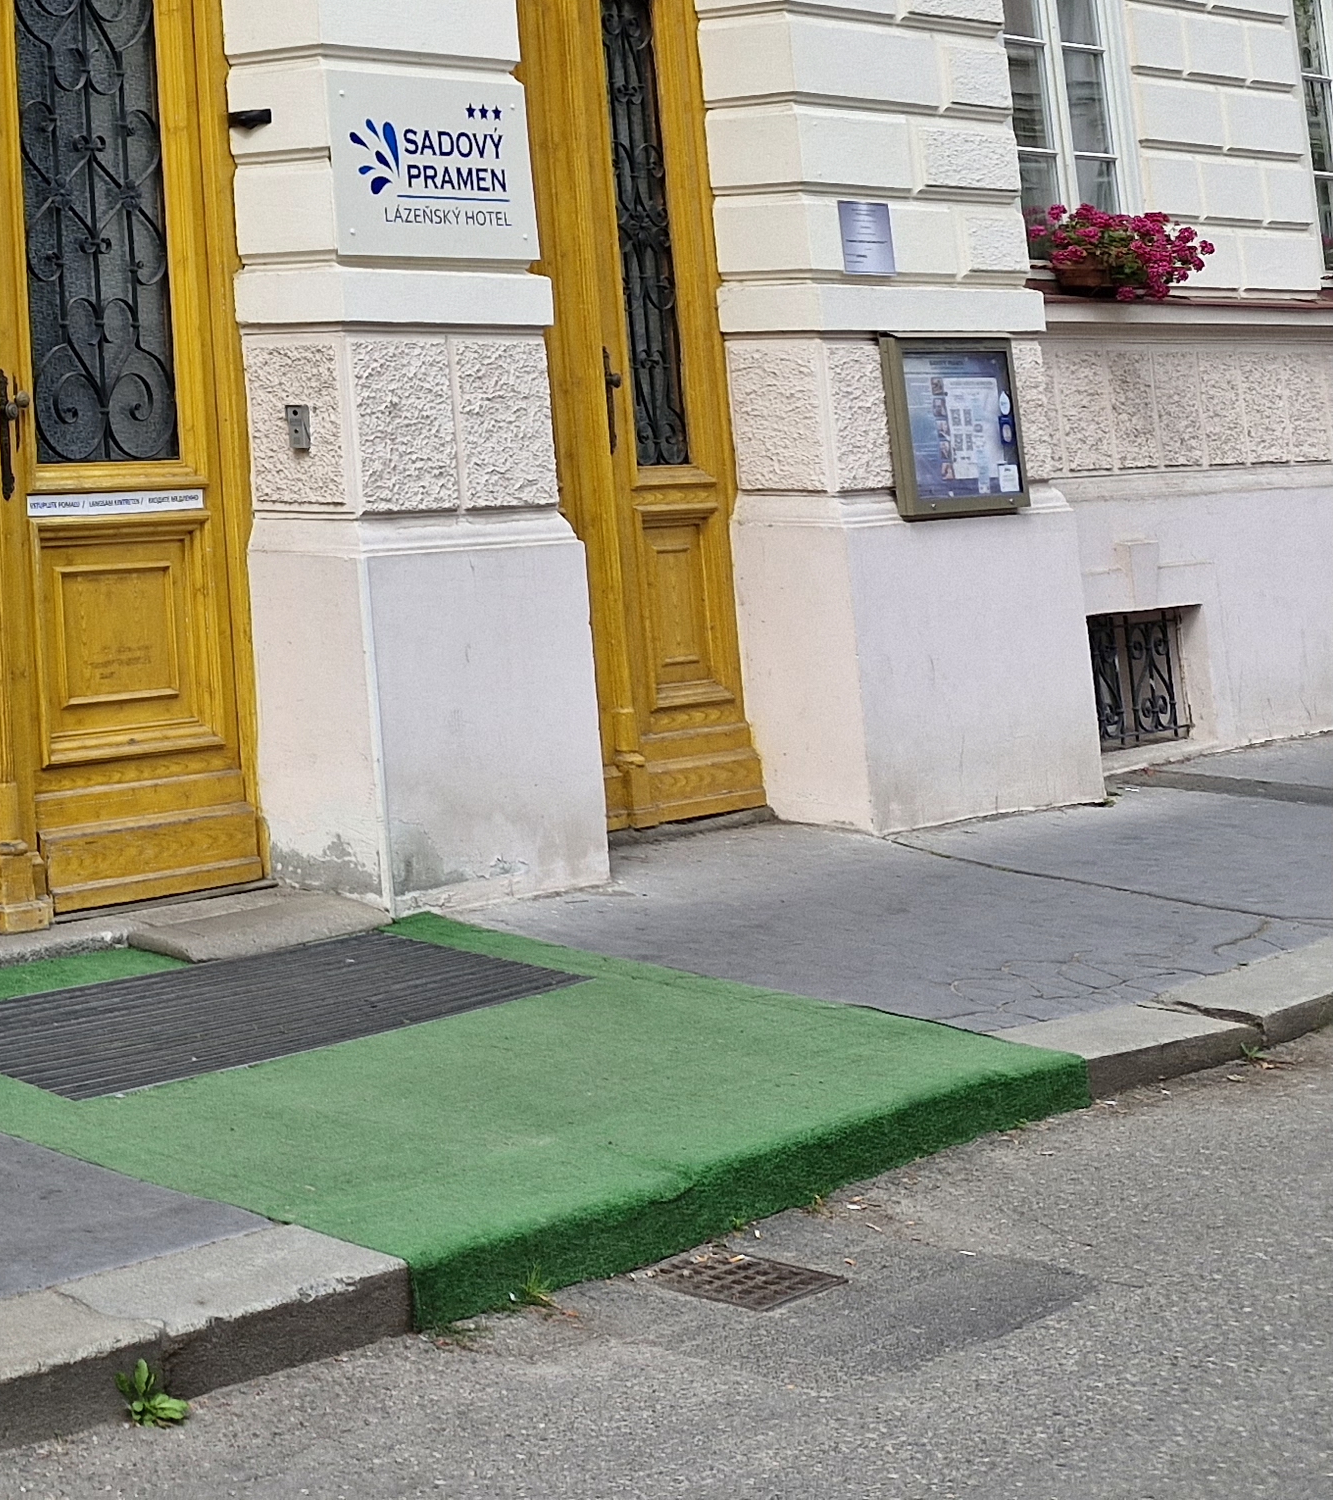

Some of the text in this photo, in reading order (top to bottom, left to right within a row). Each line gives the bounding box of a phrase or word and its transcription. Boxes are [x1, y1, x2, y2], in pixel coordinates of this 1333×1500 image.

[403, 127, 503, 159] SADOVÝ
[406, 164, 507, 192] PRAMEN
[385, 204, 512, 227] LÁZEŇSKÝ HOTEL
